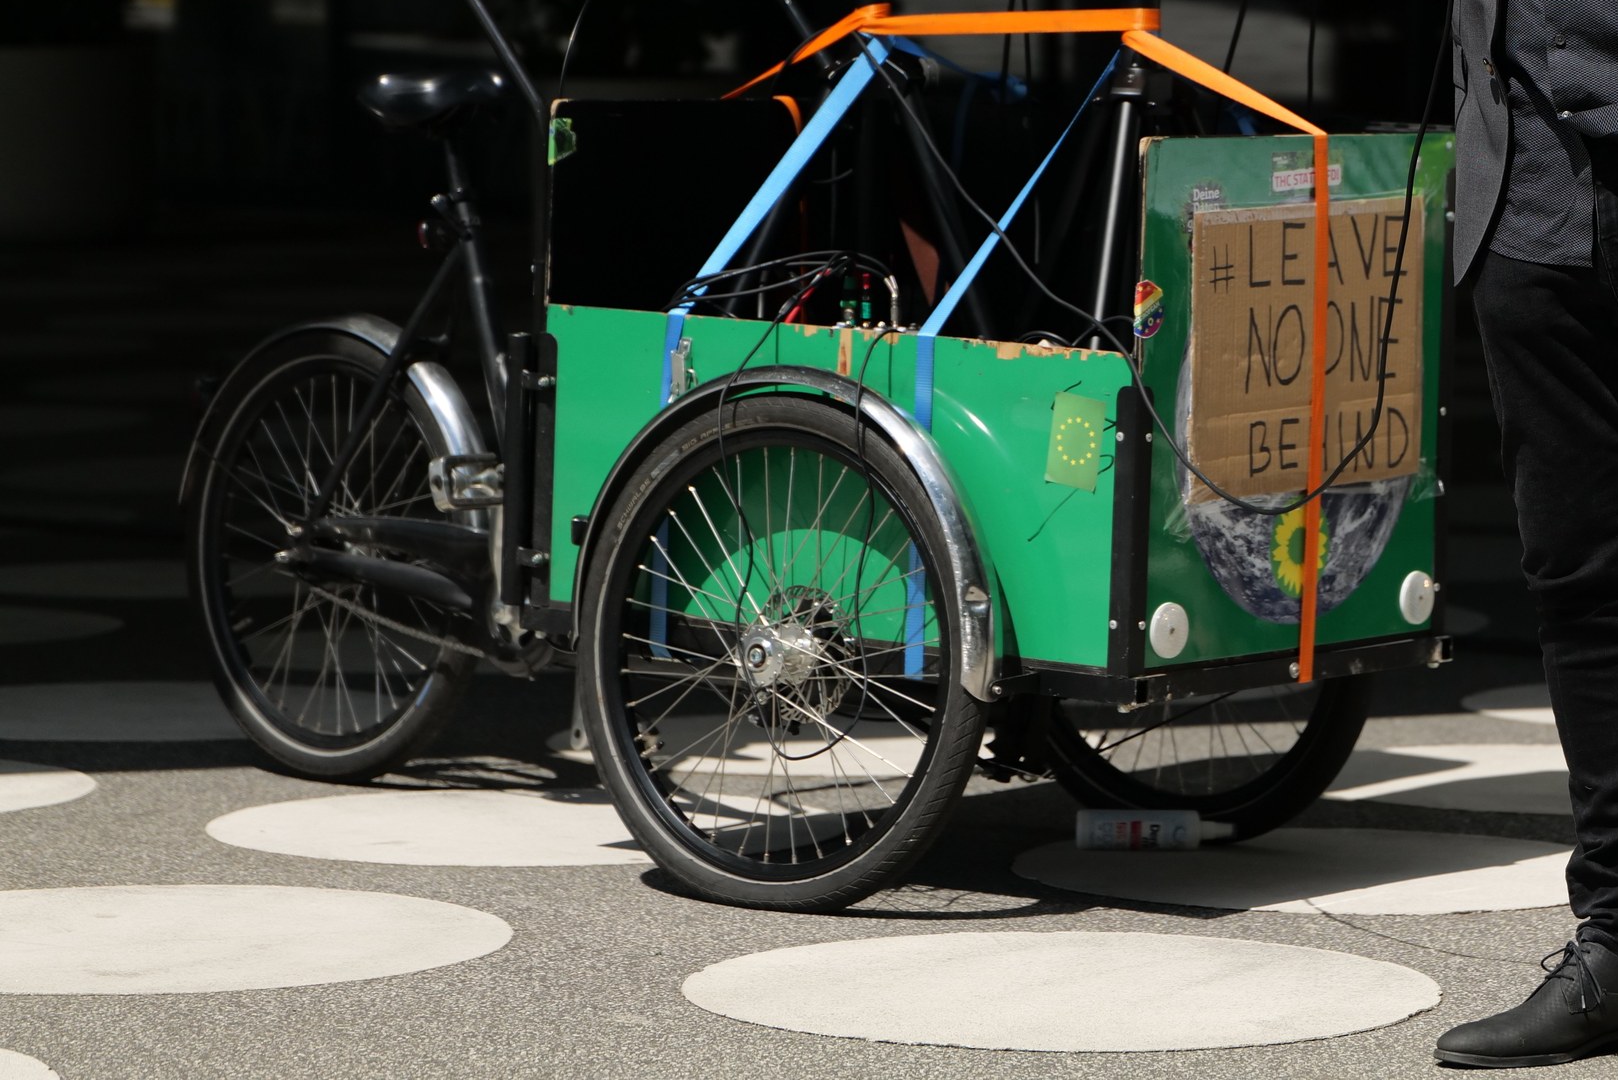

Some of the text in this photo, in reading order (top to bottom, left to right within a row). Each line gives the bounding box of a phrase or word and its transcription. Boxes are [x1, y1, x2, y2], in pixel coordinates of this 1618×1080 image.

[1274, 174, 1291, 188] THC
[1294, 171, 1316, 185] STAT
[1193, 187, 1220, 201] Deine
[1245, 295, 1403, 395] NO ONE
